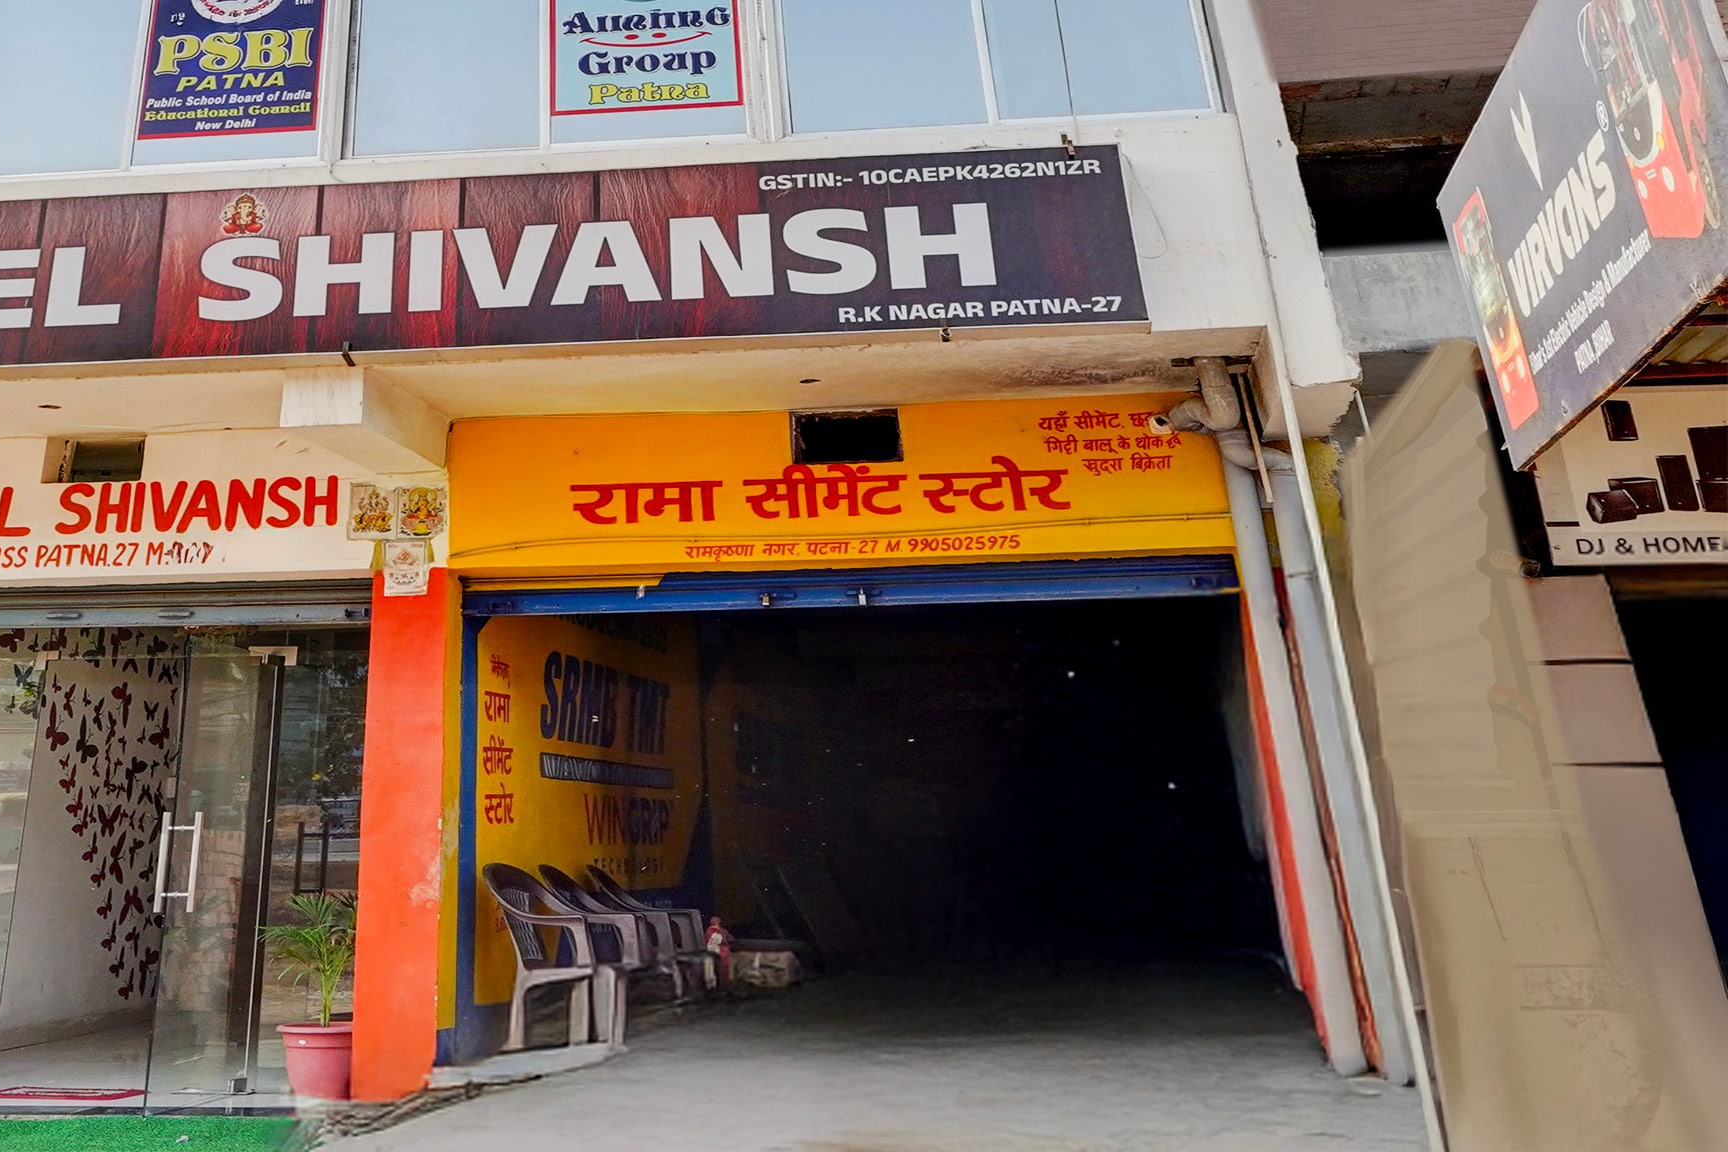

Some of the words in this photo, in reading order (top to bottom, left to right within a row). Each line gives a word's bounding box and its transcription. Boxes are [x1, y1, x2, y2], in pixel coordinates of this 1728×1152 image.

[153, 27, 314, 76] PSBI
[577, 49, 717, 76] Group
[176, 71, 285, 93] PATNA
[588, 82, 710, 105] Patna
[144, 106, 244, 122] Educational
[248, 102, 312, 115] Council
[146, 96, 183, 109] Public
[185, 95, 225, 107] School
[229, 93, 263, 104] Board
[266, 92, 279, 102] of
[282, 90, 312, 100] India
[194, 121, 222, 131] New
[224, 118, 256, 129] Delhi
[196, 201, 1000, 323] SHIVANSH
[1605, 228, 1652, 289] Manufacturer
[1601, 269, 1612, 294] &
[838, 306, 883, 323] R.K
[889, 301, 985, 320] NAGAR
[990, 296, 1122, 316] PATNA-27
[1582, 280, 1607, 314] Design
[1566, 297, 1589, 333] Vehicle
[1083, 438, 1118, 454] बालू
[1117, 435, 1130, 450] के
[1135, 433, 1163, 450] थोक
[1082, 457, 1123, 476] खुदरा
[571, 480, 723, 525] रामा
[743, 464, 908, 520] सीमेंट
[919, 455, 1071, 515] स्टोर
[55, 476, 339, 535] SHIVANSH
[1576, 539, 1604, 555] DJ
[1615, 538, 1634, 554] &
[484, 690, 511, 723] रामा
[483, 734, 514, 776] सीमेंट
[484, 782, 515, 825] स्टोर
